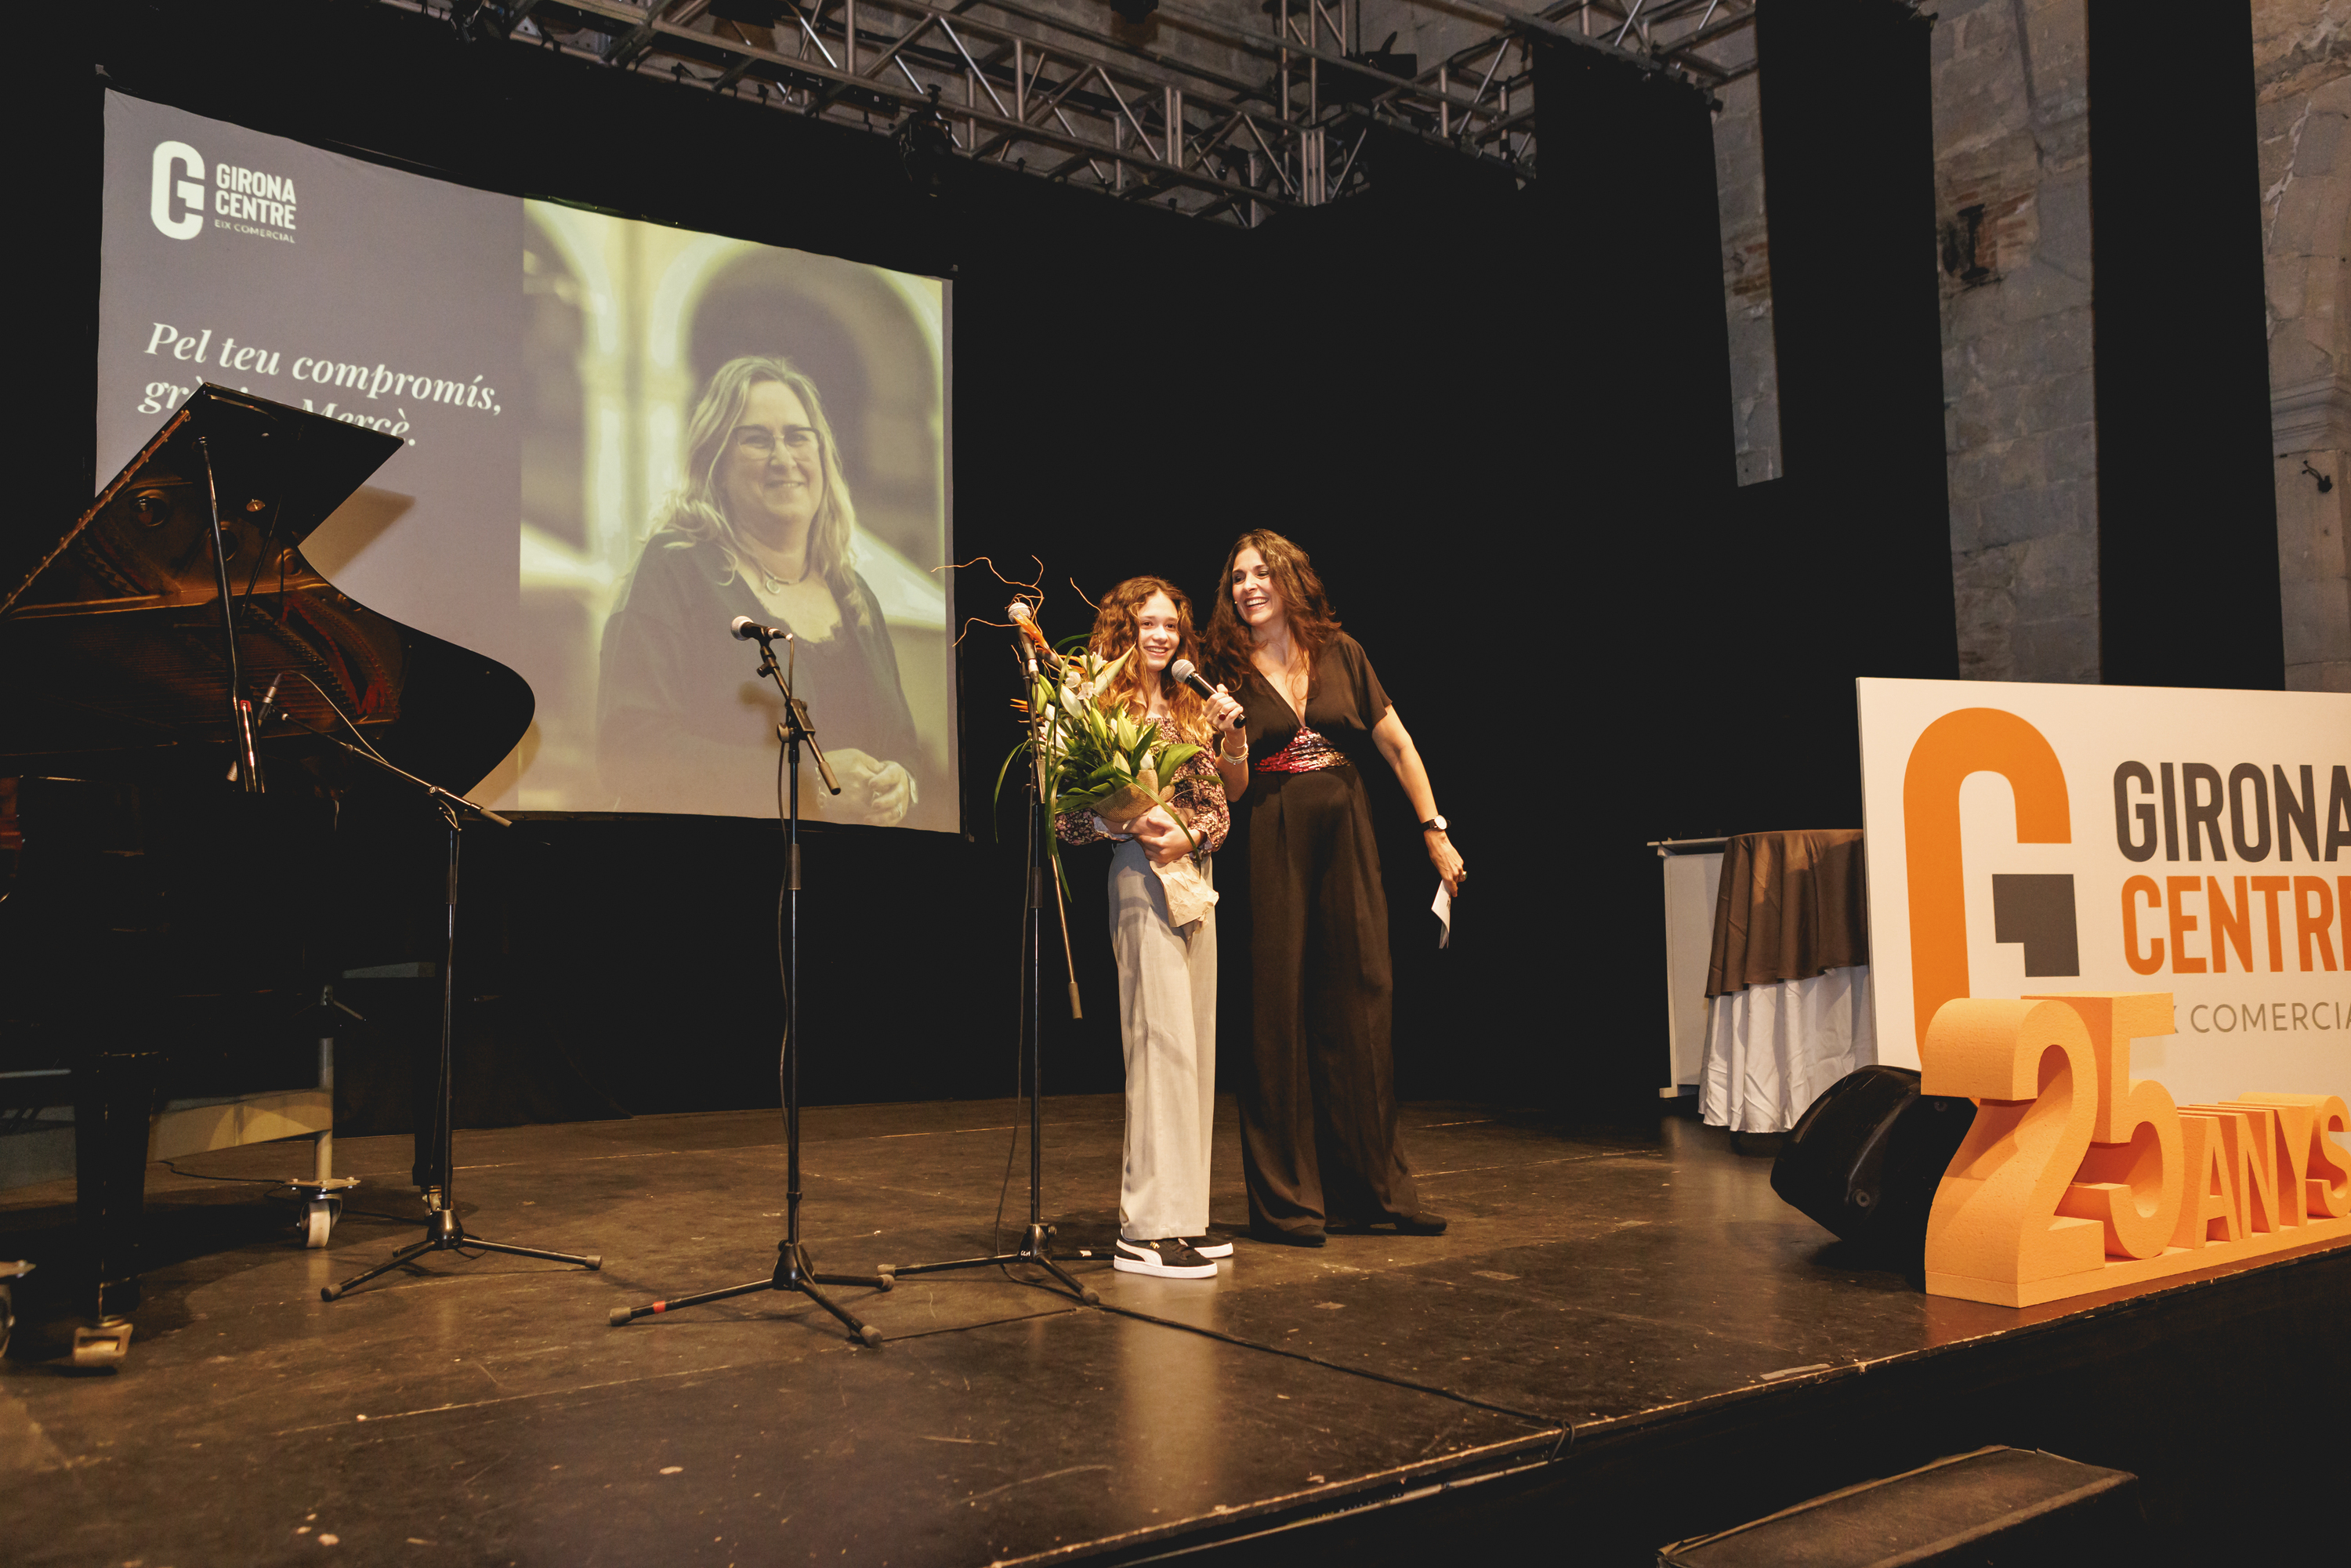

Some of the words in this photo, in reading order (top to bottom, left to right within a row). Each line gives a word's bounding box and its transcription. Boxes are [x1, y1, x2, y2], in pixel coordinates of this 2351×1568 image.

[216, 163, 297, 205] GIRONA
[216, 190, 297, 230] CENTRE
[215, 219, 232, 230] EIX
[234, 223, 296, 244] COMERCIAL
[144, 322, 212, 364] Pel
[219, 338, 281, 375] teu
[292, 355, 502, 416] compromís,
[2114, 760, 2351, 863] GIRONA
[2190, 1001, 2351, 1034] COMERCI
[1921, 992, 2184, 1293] 25
[2178, 1092, 2351, 1251] ANYS
